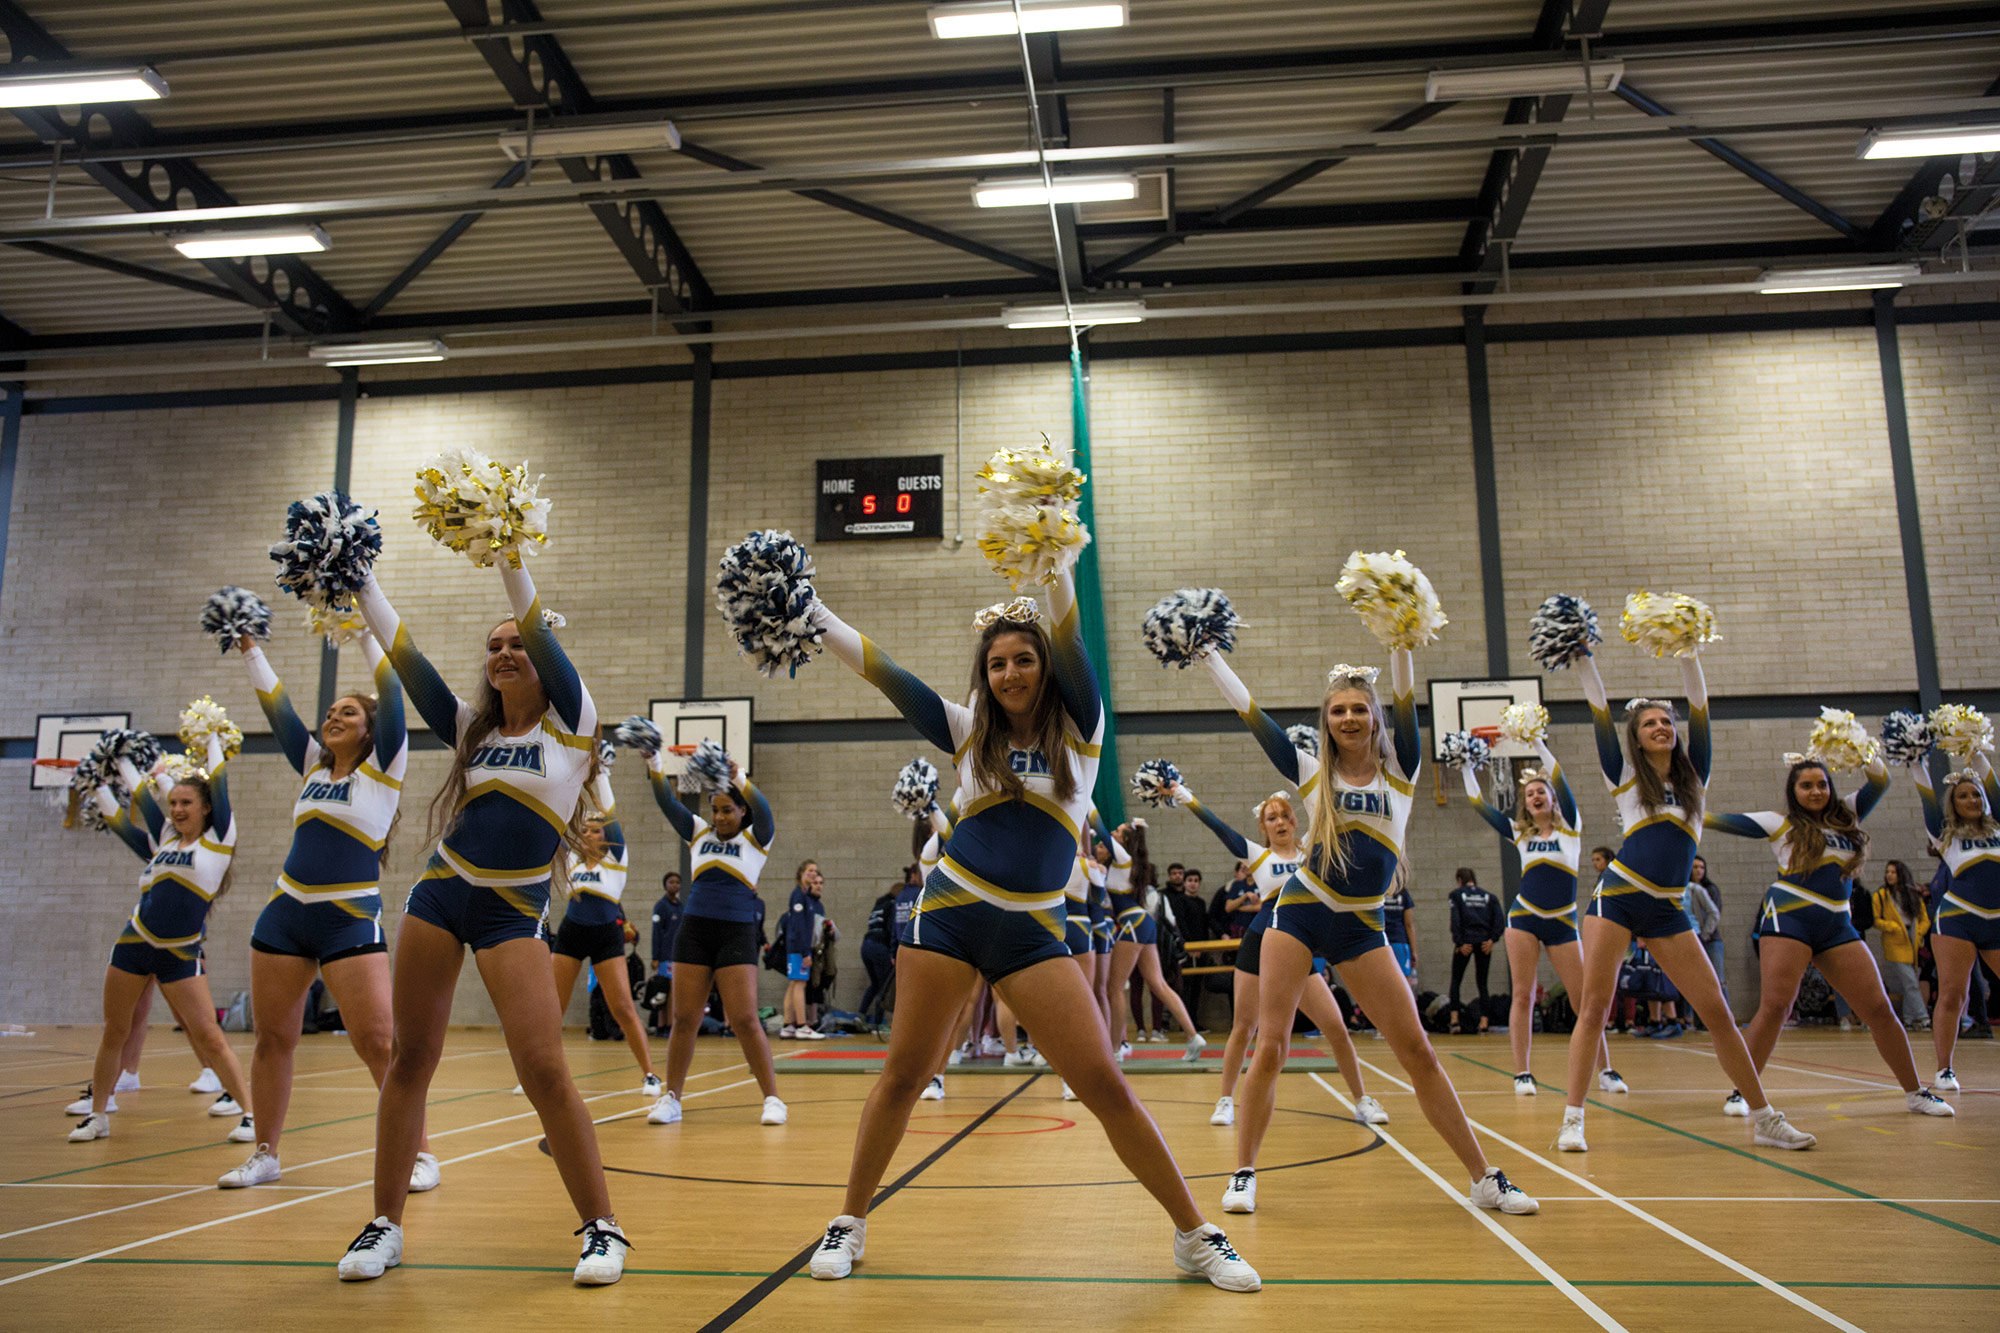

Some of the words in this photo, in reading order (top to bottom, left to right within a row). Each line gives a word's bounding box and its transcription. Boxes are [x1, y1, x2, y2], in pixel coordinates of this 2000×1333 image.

[822, 479, 855, 494] HOME
[898, 475, 942, 491] GUESTS
[863, 494, 876, 514] 5
[896, 493, 911, 513] 0
[845, 521, 914, 533] CONTINENTAL
[466, 744, 544, 772] UGM
[1007, 750, 1051, 775] GM
[300, 781, 351, 803] UGM
[699, 841, 741, 857] UGM
[1527, 840, 1561, 852] UGM
[1825, 833, 1855, 851] GM
[154, 850, 194, 867] UGM
[572, 871, 601, 882] UGM
[1272, 863, 1298, 876] UG
